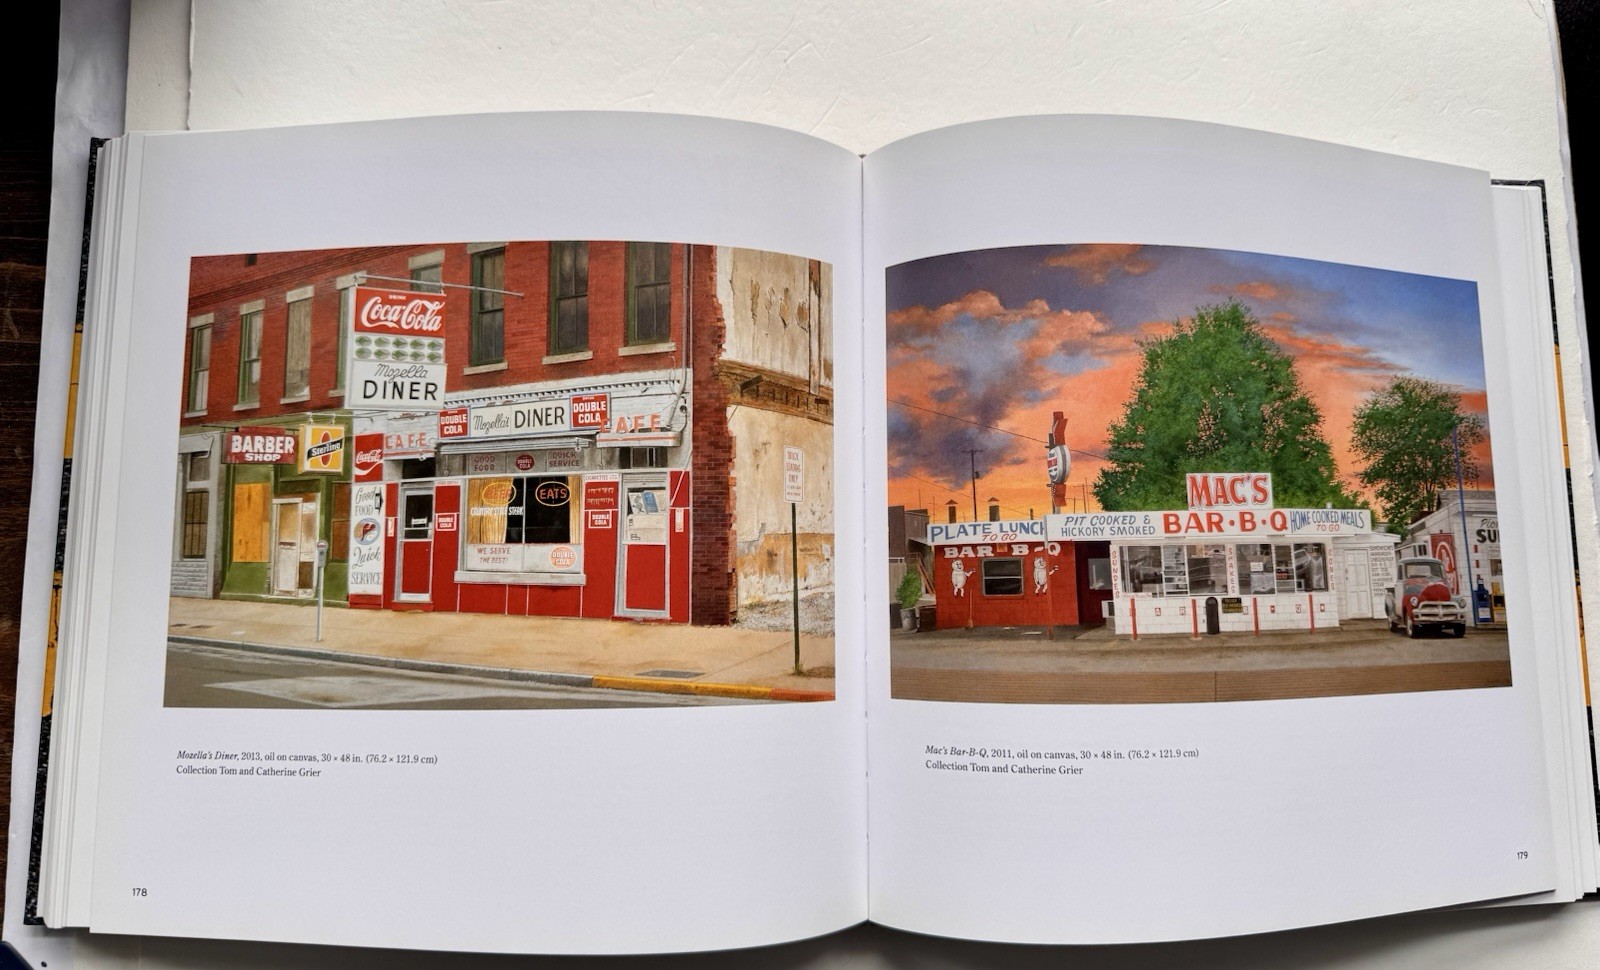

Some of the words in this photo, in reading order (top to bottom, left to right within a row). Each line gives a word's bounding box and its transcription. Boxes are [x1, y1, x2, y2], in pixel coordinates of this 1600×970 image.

[361, 296, 445, 331] Coca-Cola
[374, 363, 428, 384] Mozella
[363, 380, 438, 401] DINER
[573, 401, 606, 413] DOUBLE
[440, 414, 467, 425] DOUBLE
[473, 413, 509, 434] Mozella's
[514, 406, 565, 429] DINER
[578, 412, 602, 423] COLA
[600, 412, 661, 434] CAFE
[444, 425, 463, 434] COLA
[231, 435, 295, 454] BARBER
[385, 432, 427, 449] CAFE
[311, 441, 341, 456] Sterling
[552, 451, 576, 459] QUICK
[245, 453, 281, 461] SHOP
[474, 455, 495, 463] GOOD
[540, 488, 567, 499] EATS
[1188, 474, 1269, 508] MAC'S
[508, 506, 524, 515] STEAK
[1064, 516, 1087, 526] PIT
[1090, 515, 1137, 526] COOKED
[1143, 515, 1151, 525] &
[1290, 511, 1311, 533] HOME
[1311, 510, 1339, 524] COOKED
[1340, 510, 1365, 529] MEALS
[930, 523, 992, 543] PLATE
[1061, 527, 1105, 537] HICKORY
[1110, 525, 1156, 535] SMOKED
[1316, 524, 1327, 532] TO
[1328, 524, 1340, 532] GO
[1001, 533, 1017, 541] GO
[352, 546, 381, 570] Quick
[1228, 547, 1237, 593] SHAKES
[351, 572, 382, 585] SERVICE
[177, 750, 213, 760] Mozella's
[214, 751, 239, 761] Diner,
[241, 752, 262, 761] 2013,
[264, 752, 275, 761] oil
[288, 754, 319, 763] canvas,
[321, 753, 331, 762] 30
[340, 753, 351, 762] 48
[352, 753, 363, 762] in.
[366, 754, 387, 764] (76.2
[396, 754, 419, 763] 121.9
[420, 754, 438, 764] cm)
[925, 745, 948, 755] Mac's
[950, 746, 989, 758] Bar-B-Q,
[991, 748, 1015, 759] 2011,
[1016, 749, 1029, 759] oil
[1030, 751, 1042, 759] on
[1044, 751, 1078, 760] canvas,
[1080, 750, 1091, 759] 30
[1100, 750, 1112, 759] 48
[1113, 750, 1125, 759] in.
[1128, 750, 1149, 760] (76.2
[1159, 749, 1181, 759] 121.9
[1183, 748, 1199, 759] cm)
[176, 765, 217, 775] Collection
[220, 766, 237, 775] Tom
[239, 766, 254, 776] and
[256, 766, 297, 777] Catherine
[298, 767, 321, 777] Grier
[925, 760, 968, 771] Collection
[970, 762, 990, 773] Tom
[991, 763, 1009, 773] and
[1011, 764, 1057, 774] Catherine
[1058, 765, 1083, 775] Grier
[1517, 851, 1528, 860] 179
[132, 887, 148, 897] 178
